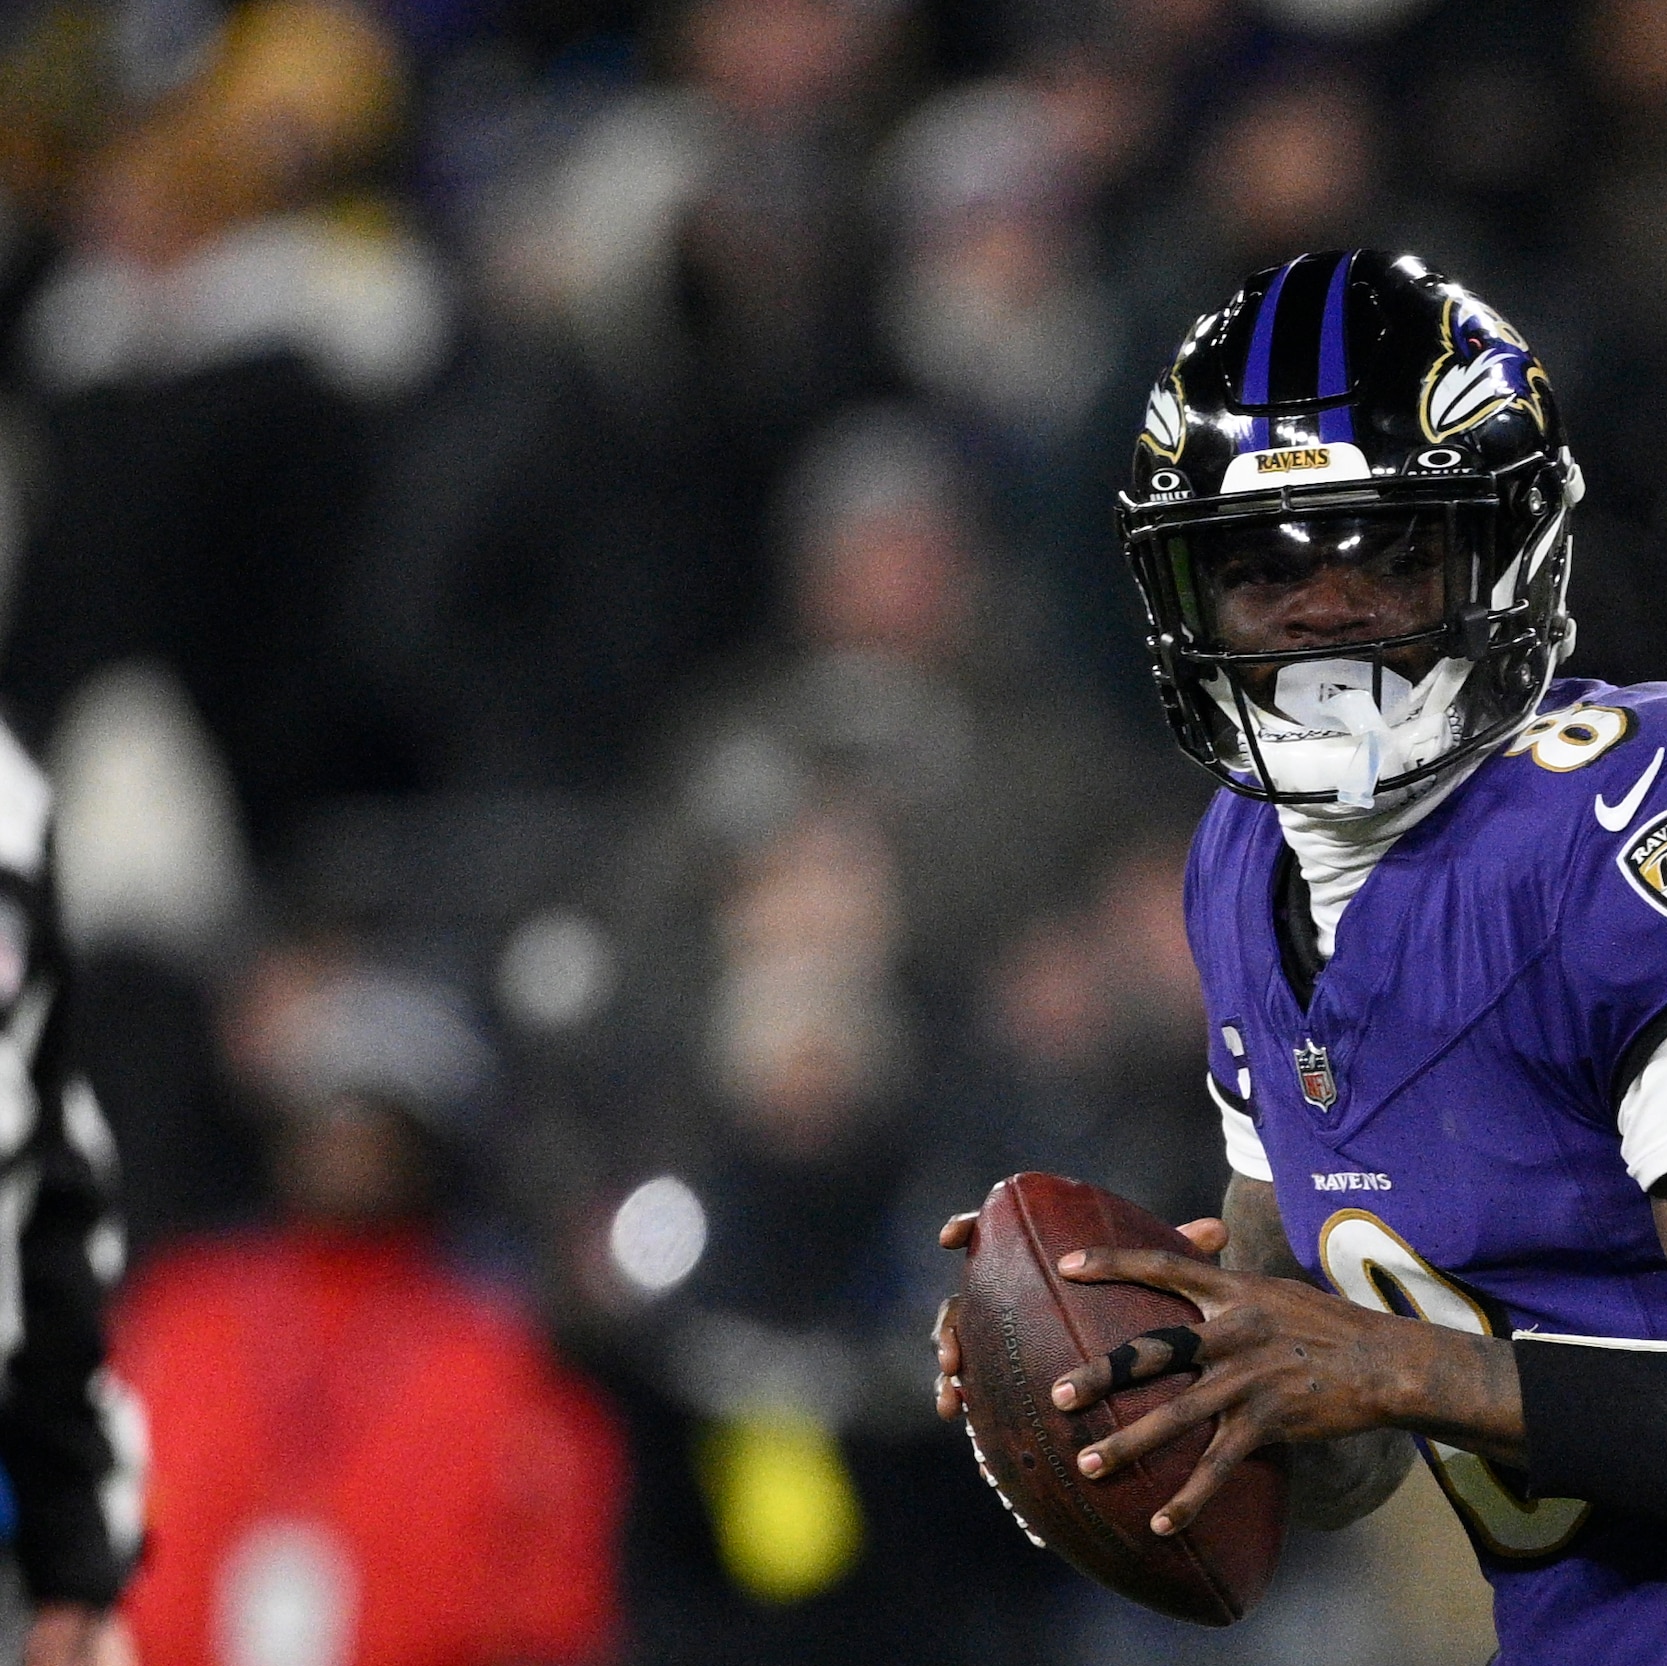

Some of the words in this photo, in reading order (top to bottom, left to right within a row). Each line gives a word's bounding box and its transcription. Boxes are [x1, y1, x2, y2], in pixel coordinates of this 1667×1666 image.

[1254, 448, 1331, 474] RAVENS
[1503, 701, 1640, 773] 8
[1311, 1172, 1393, 1193] RAVENS
